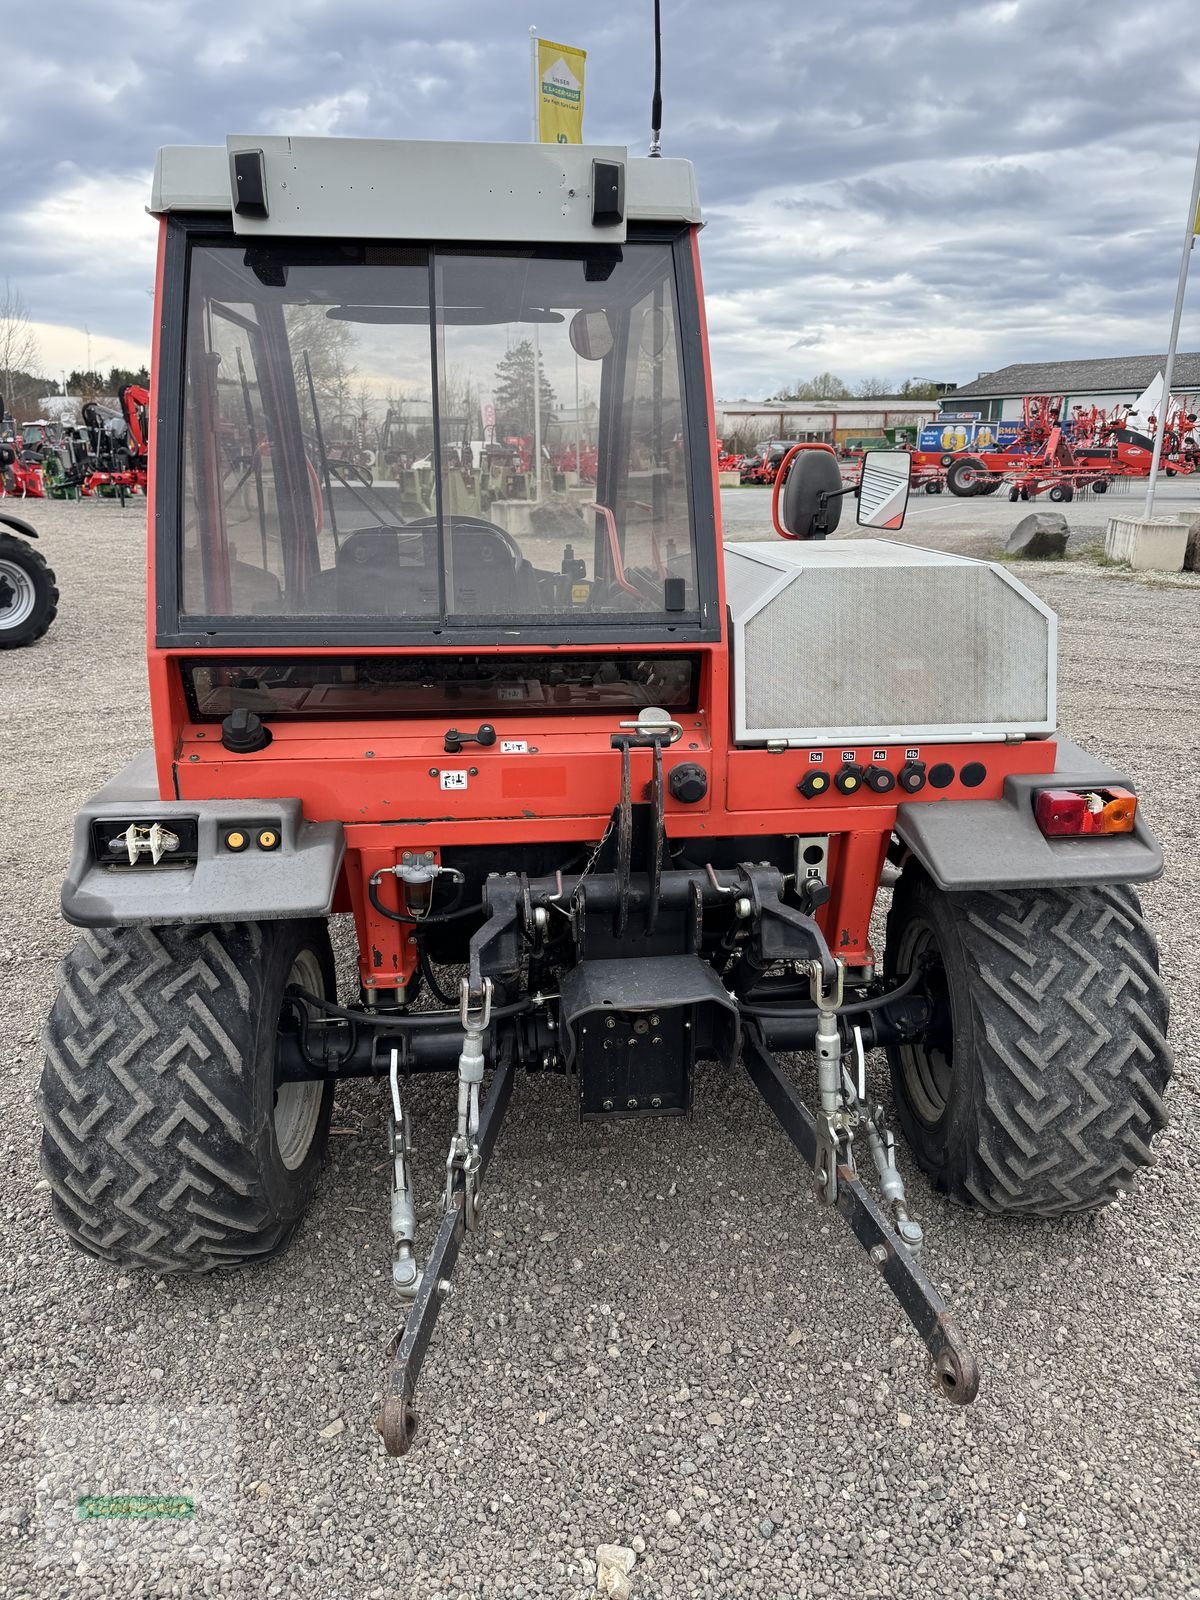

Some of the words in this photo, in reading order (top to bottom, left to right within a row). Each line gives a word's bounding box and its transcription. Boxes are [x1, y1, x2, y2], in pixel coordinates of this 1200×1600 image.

[811, 753, 821, 761] 3a
[843, 752, 854, 760] 3b
[874, 752, 885, 760] 4a
[907, 750, 918, 758] 4b
